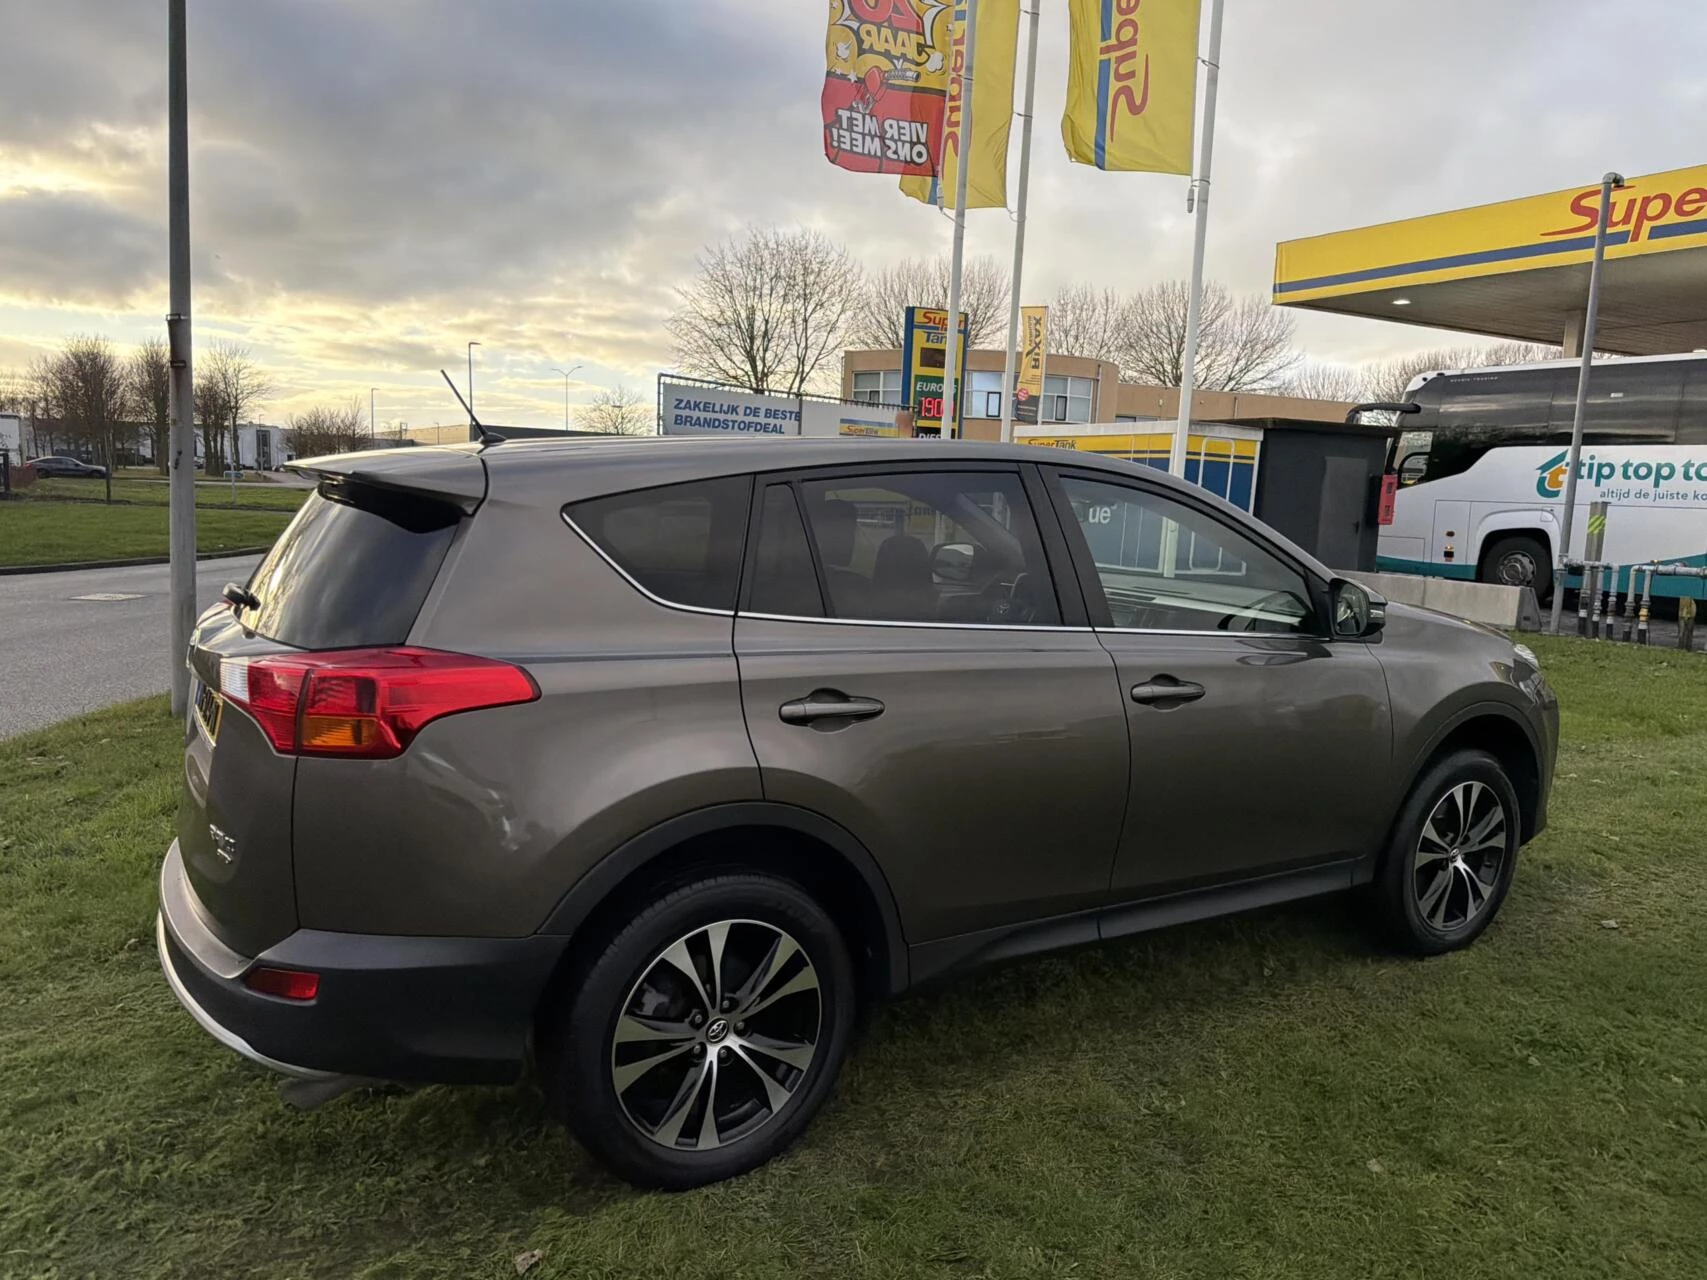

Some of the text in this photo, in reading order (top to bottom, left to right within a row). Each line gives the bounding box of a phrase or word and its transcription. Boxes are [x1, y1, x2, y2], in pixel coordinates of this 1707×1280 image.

[673, 398, 800, 422] ZAKELIJK DE BESTE
[674, 414, 785, 435] BRANDSTOFDEAL
[1621, 459, 1676, 488] top
[1600, 488, 1630, 501] altijd
[1634, 489, 1650, 499] de
[1653, 490, 1688, 502] juiste
